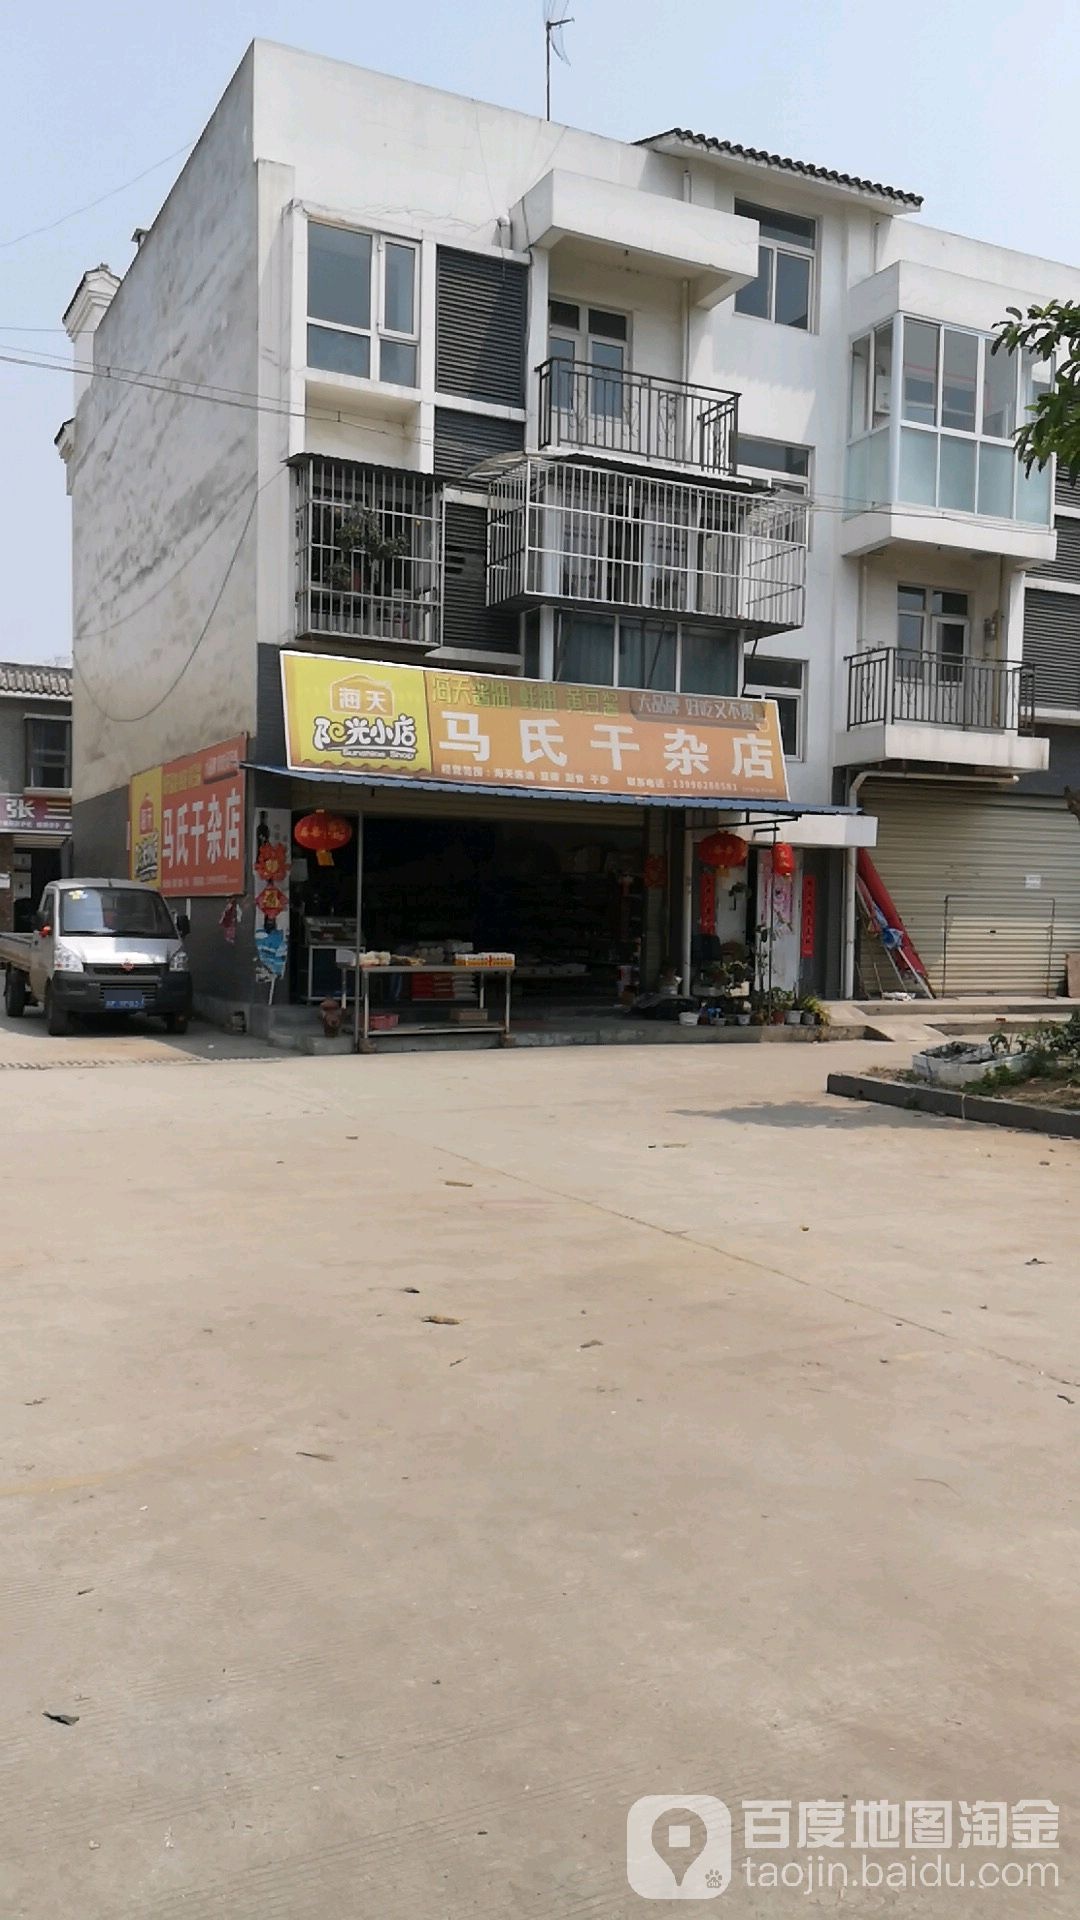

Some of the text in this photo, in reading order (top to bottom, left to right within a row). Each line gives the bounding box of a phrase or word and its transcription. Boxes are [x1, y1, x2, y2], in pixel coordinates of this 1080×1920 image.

[339, 687, 386, 712] 海天
[433, 676, 511, 707] 海天酱油
[639, 694, 755, 721] 大品牌 好吃又不贵
[314, 714, 416, 750] 阳光小店
[438, 710, 775, 780] 马氏干杂店
[162, 787, 241, 869] 马氏干杂店
